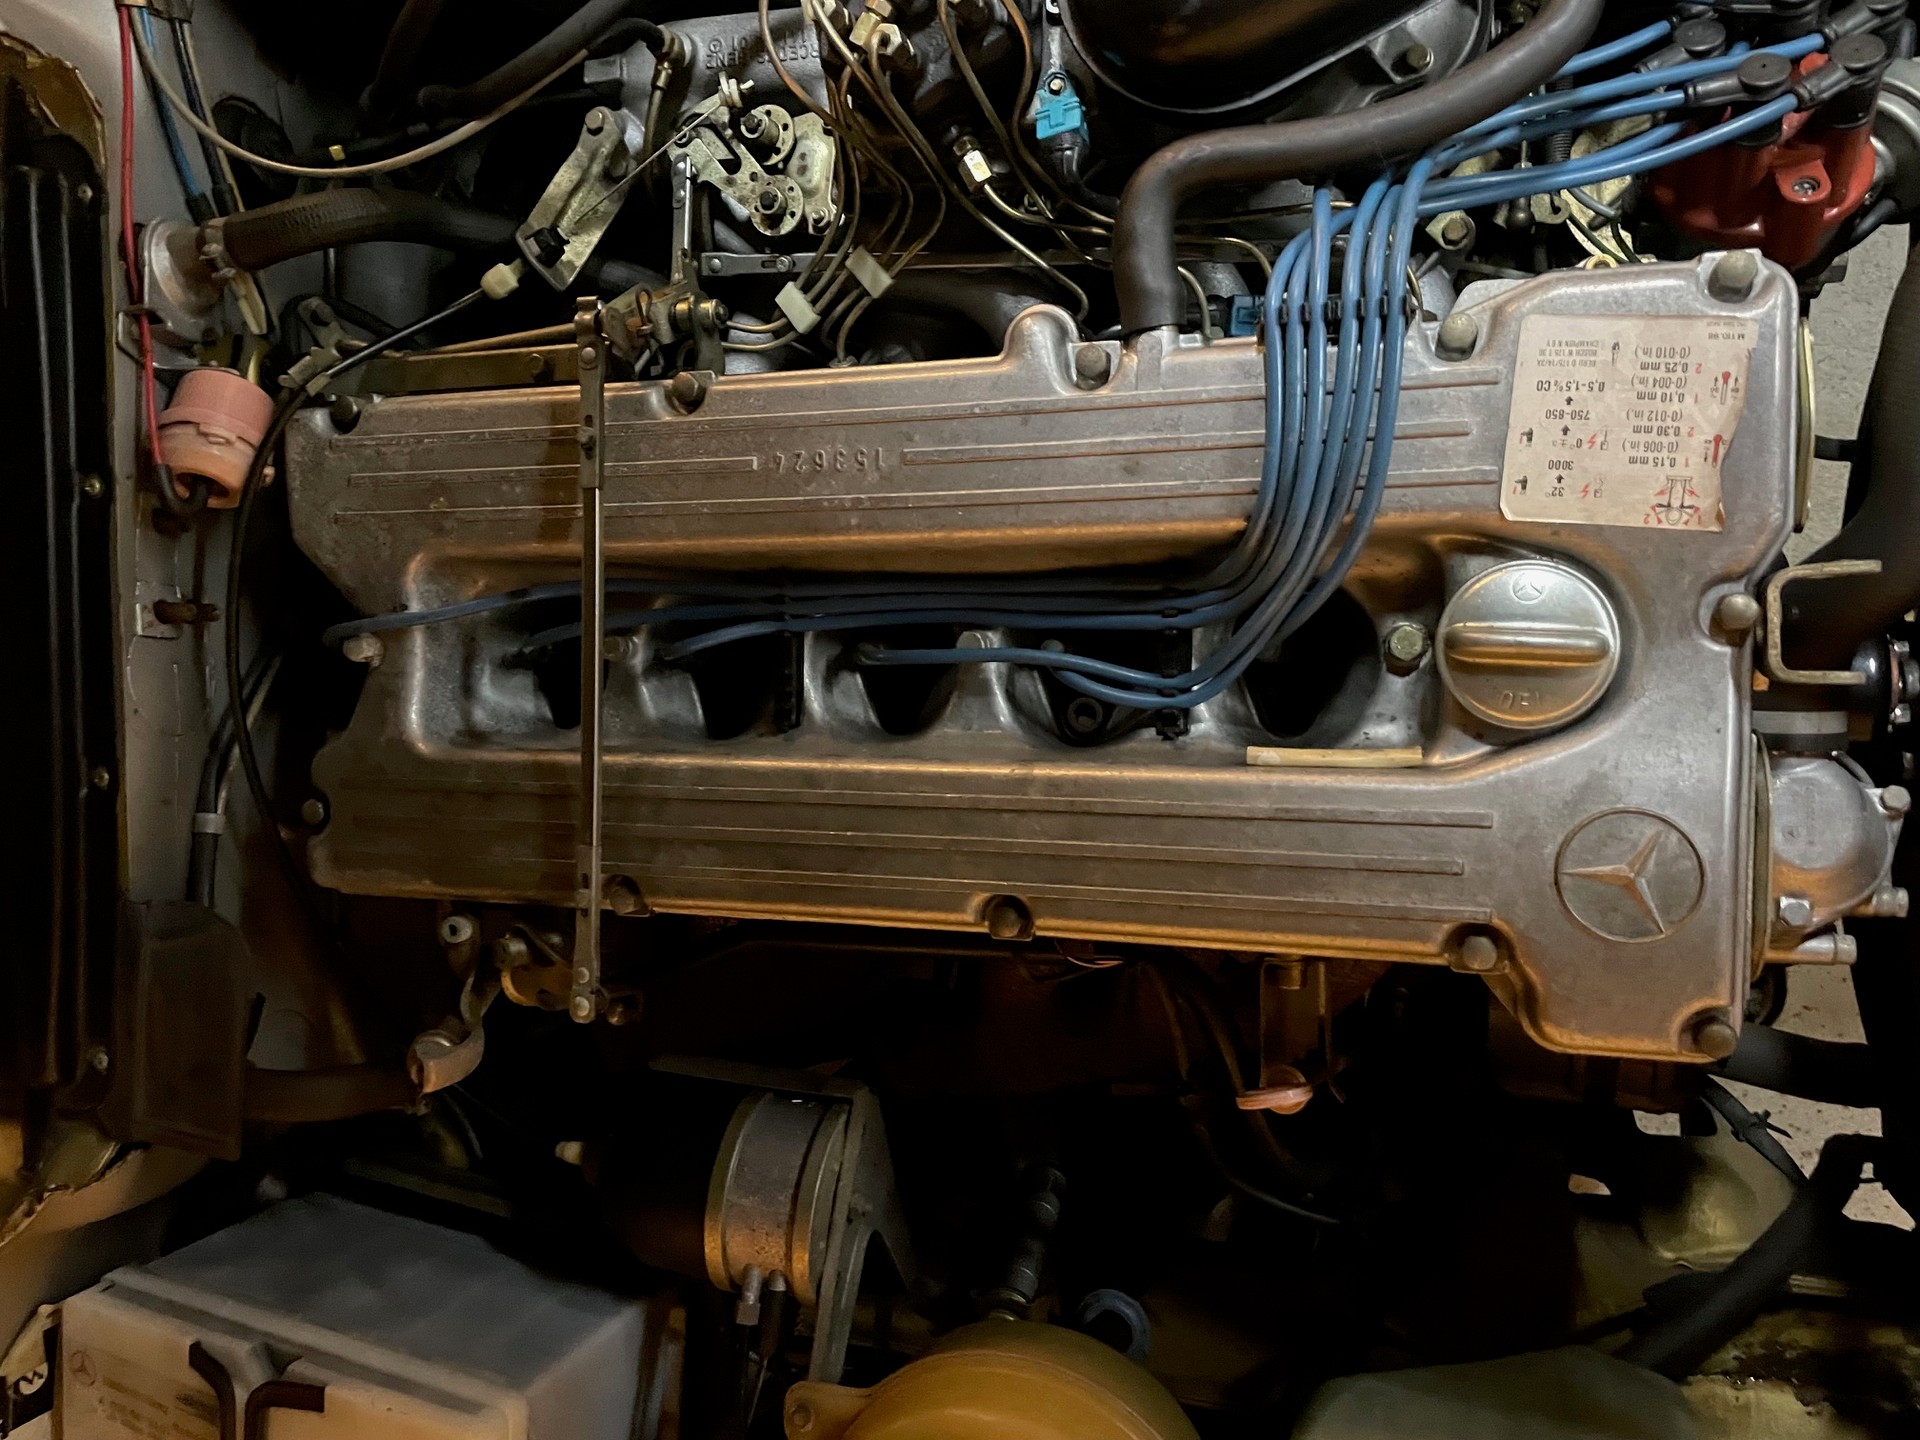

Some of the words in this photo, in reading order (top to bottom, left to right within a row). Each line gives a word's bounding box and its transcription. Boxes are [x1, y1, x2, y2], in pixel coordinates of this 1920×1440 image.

[1640, 361, 1661, 371] mm
[1664, 360, 1689, 373] 0,25
[1696, 363, 1702, 373] 2
[1536, 380, 1551, 392] CO
[1636, 391, 1657, 400] mm
[1661, 391, 1685, 402] 0,10
[1694, 393, 1699, 403] 1
[1545, 408, 1591, 420] 750-850
[1632, 424, 1653, 434] mm
[1656, 424, 1680, 436] 0,30
[1687, 426, 1695, 436] 2
[1548, 459, 1574, 471] 3000
[1628, 456, 1649, 465] mm
[1652, 455, 1677, 467] 0,15
[1685, 457, 1689, 467] 1
[1544, 486, 1565, 498] 32°
[1643, 513, 1650, 523] 2
